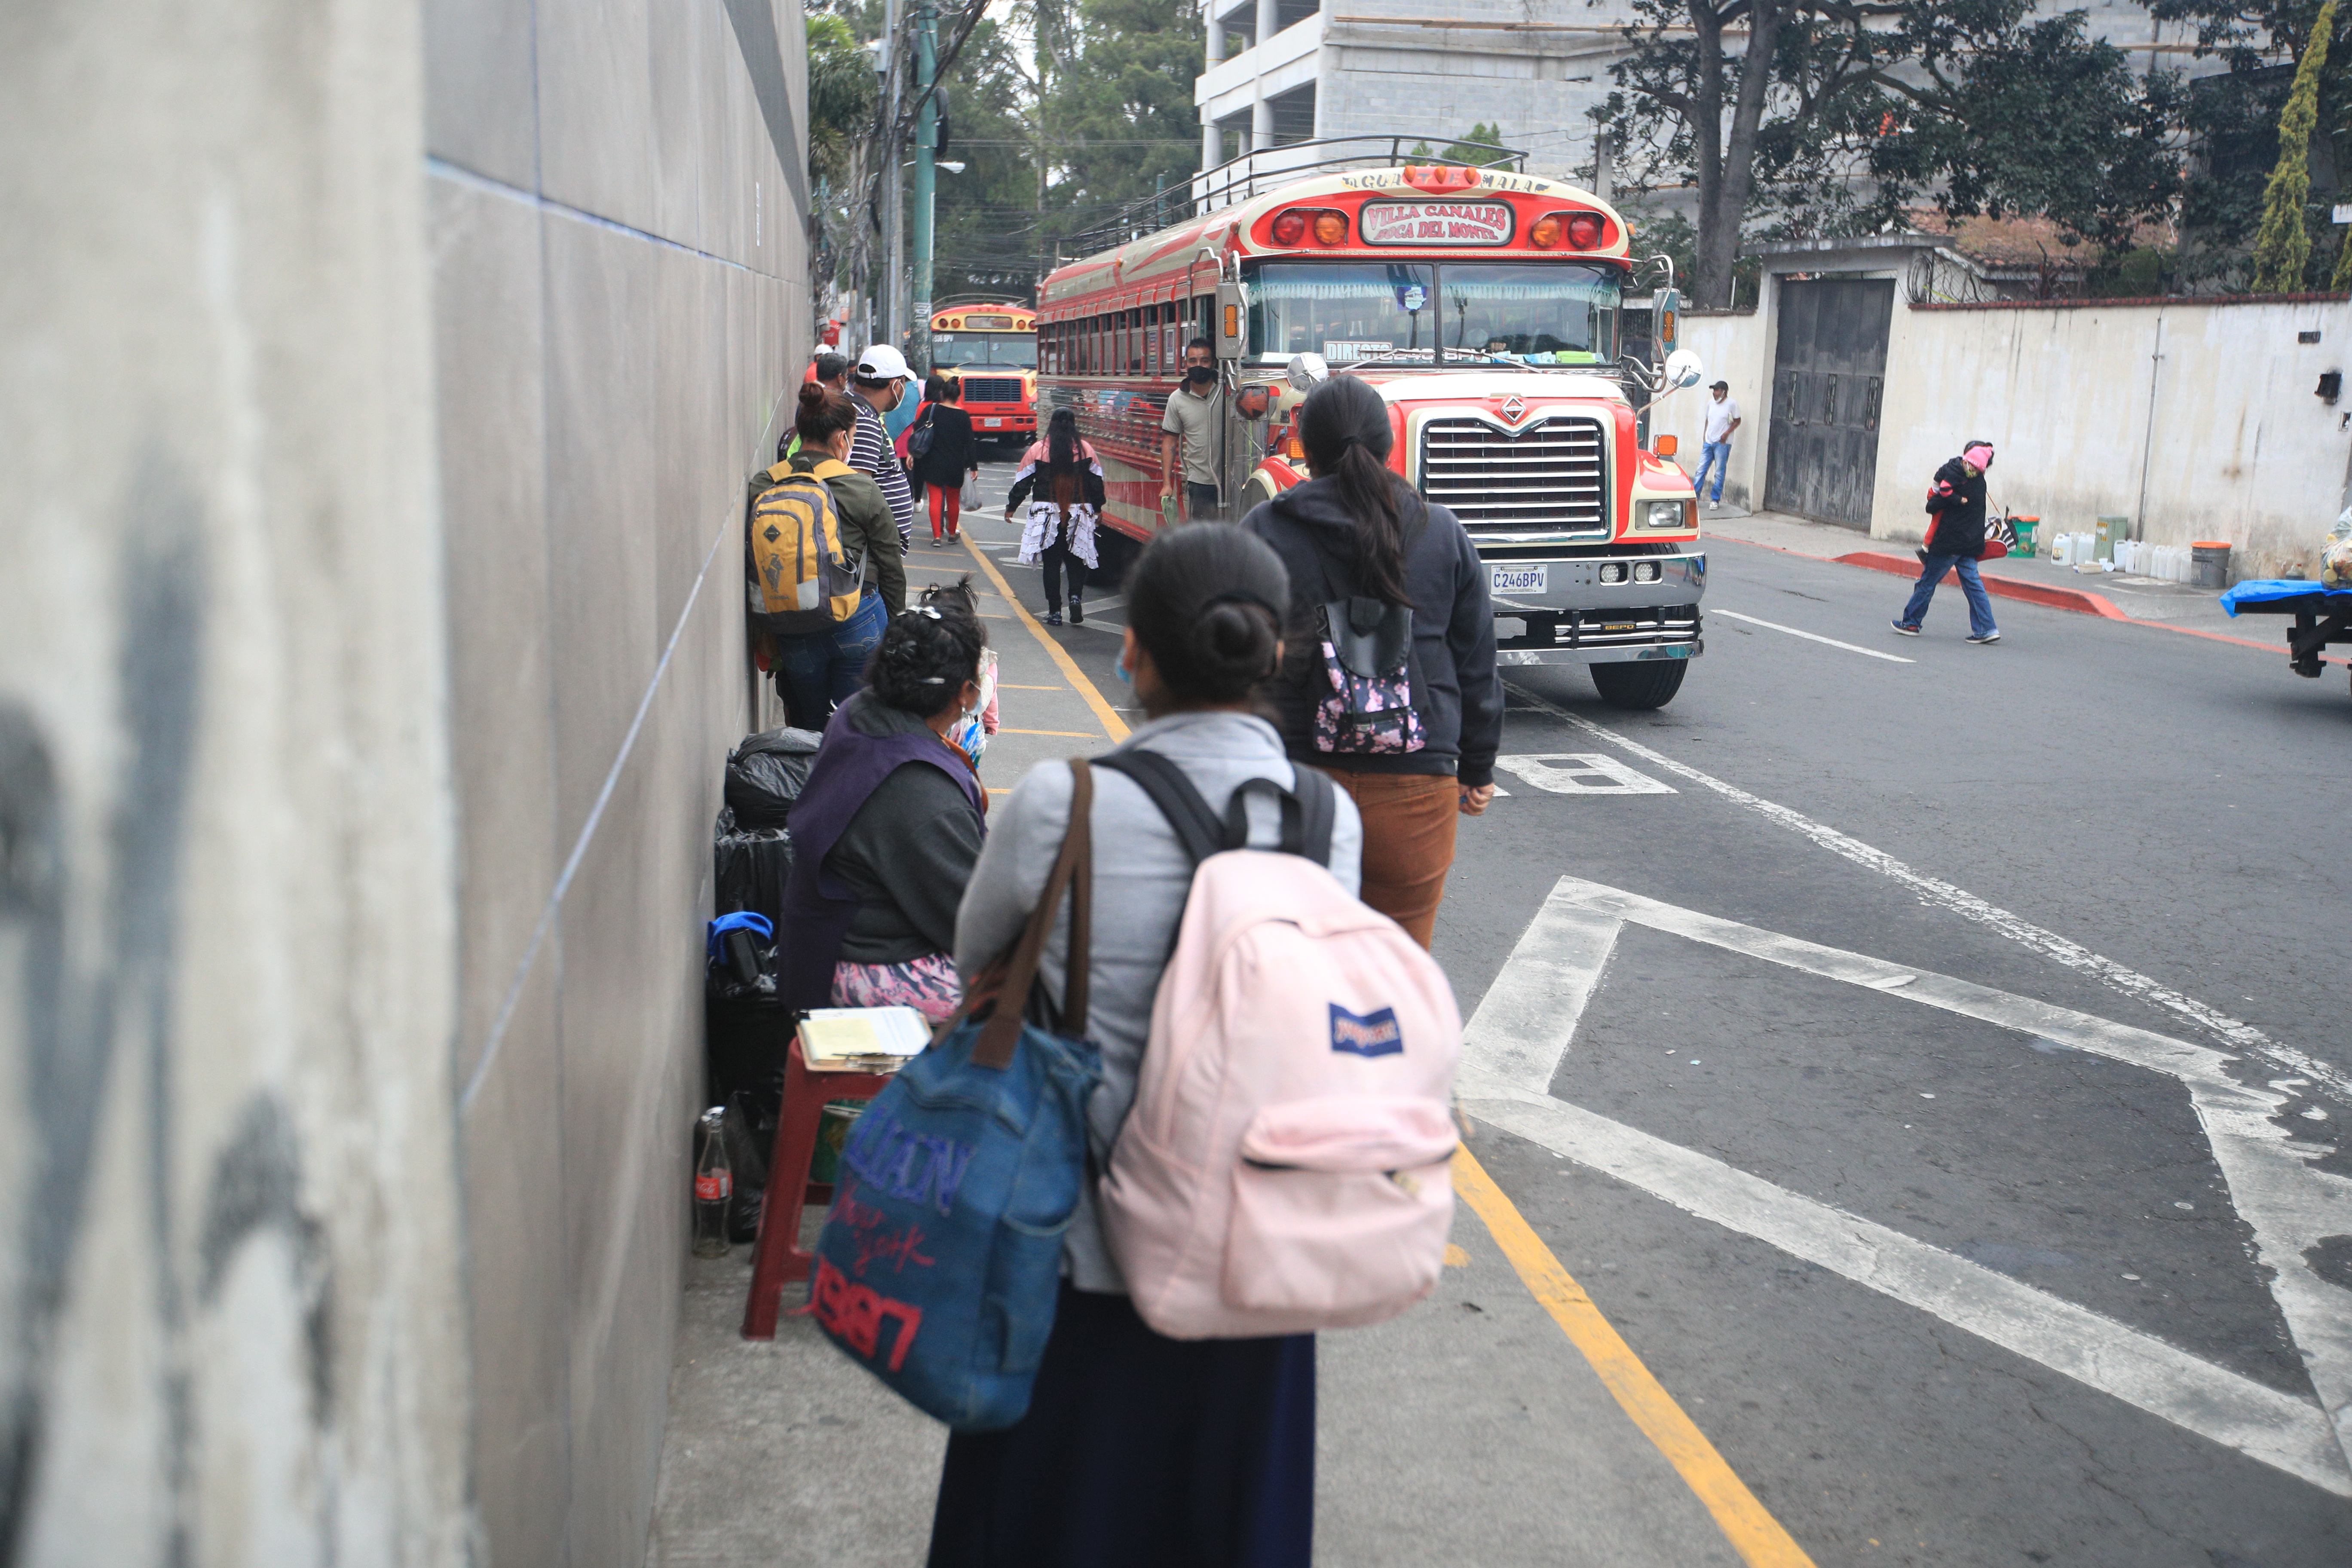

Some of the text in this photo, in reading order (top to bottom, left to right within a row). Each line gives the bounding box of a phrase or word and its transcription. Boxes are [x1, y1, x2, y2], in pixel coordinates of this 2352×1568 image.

[1367, 206, 1506, 231] VILLA CANALES
[1374, 221, 1499, 240] BOCA DEL MONTE
[1494, 573, 1544, 587] C246BPV
